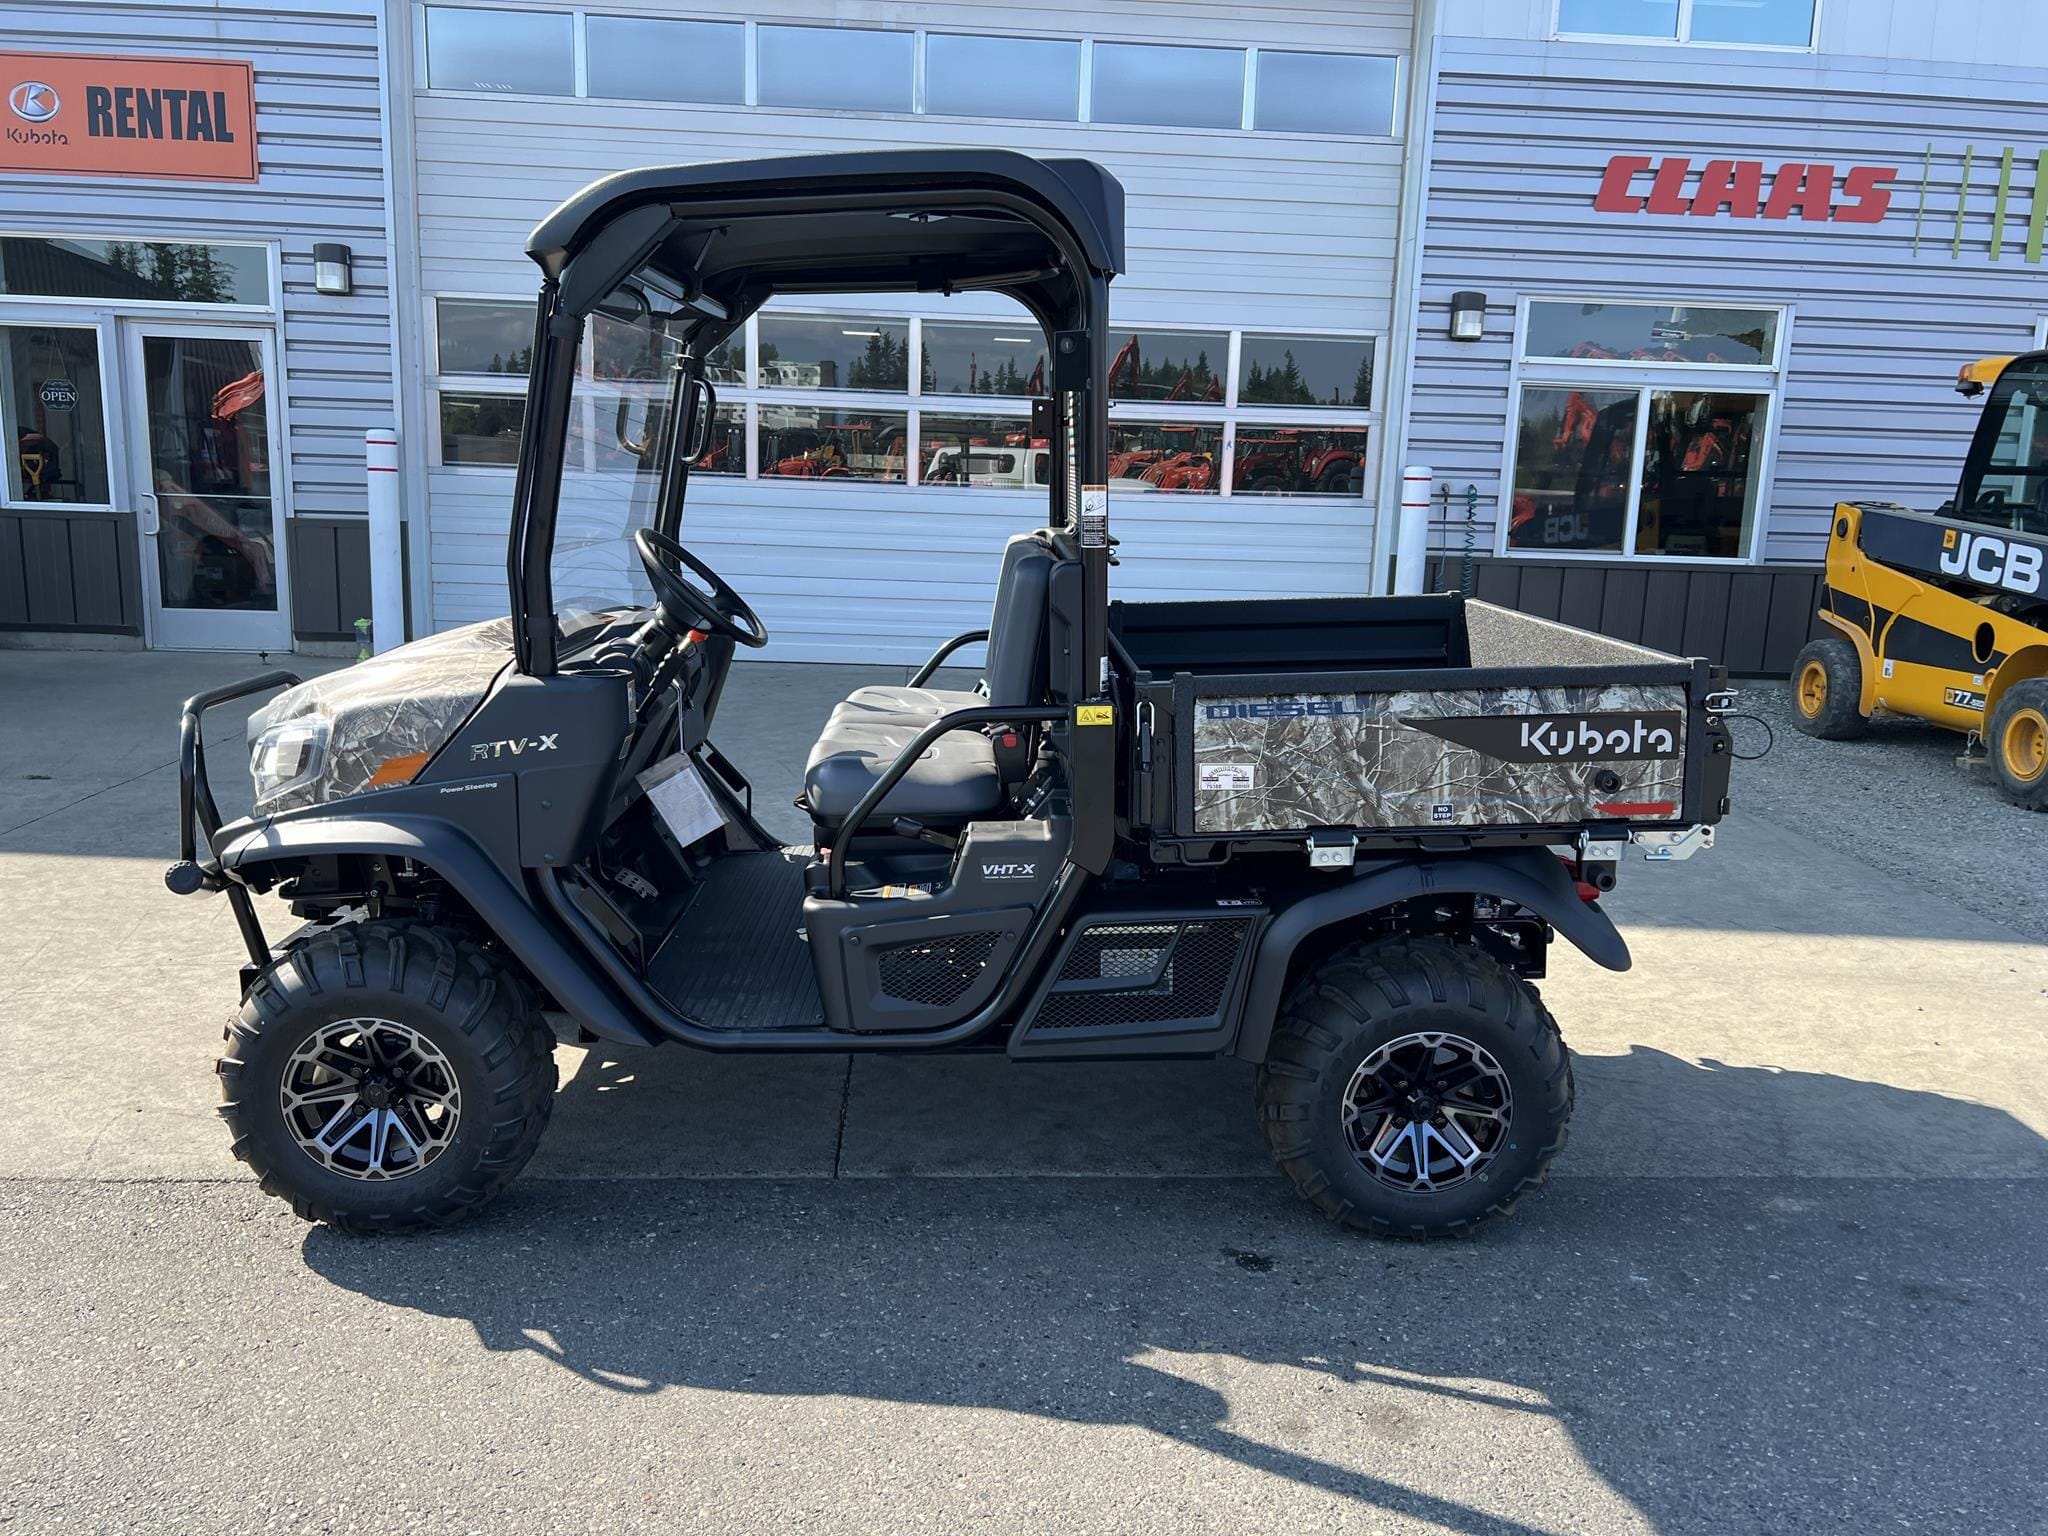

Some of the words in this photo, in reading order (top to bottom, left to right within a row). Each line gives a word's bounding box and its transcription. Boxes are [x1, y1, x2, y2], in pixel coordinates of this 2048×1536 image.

[86, 85, 234, 143] RENTAL
[7, 128, 69, 145] Kubota
[1594, 156, 1899, 224] CLAAS
[41, 391, 76, 402] OPEN
[1940, 533, 2043, 594] JCB
[1206, 701, 1364, 719] DIESEL
[470, 733, 559, 761] RTV-X
[1521, 719, 1673, 756] Kubota
[440, 785, 465, 794] Power
[465, 782, 498, 791] Steering
[982, 863, 1036, 875] VHT-X
